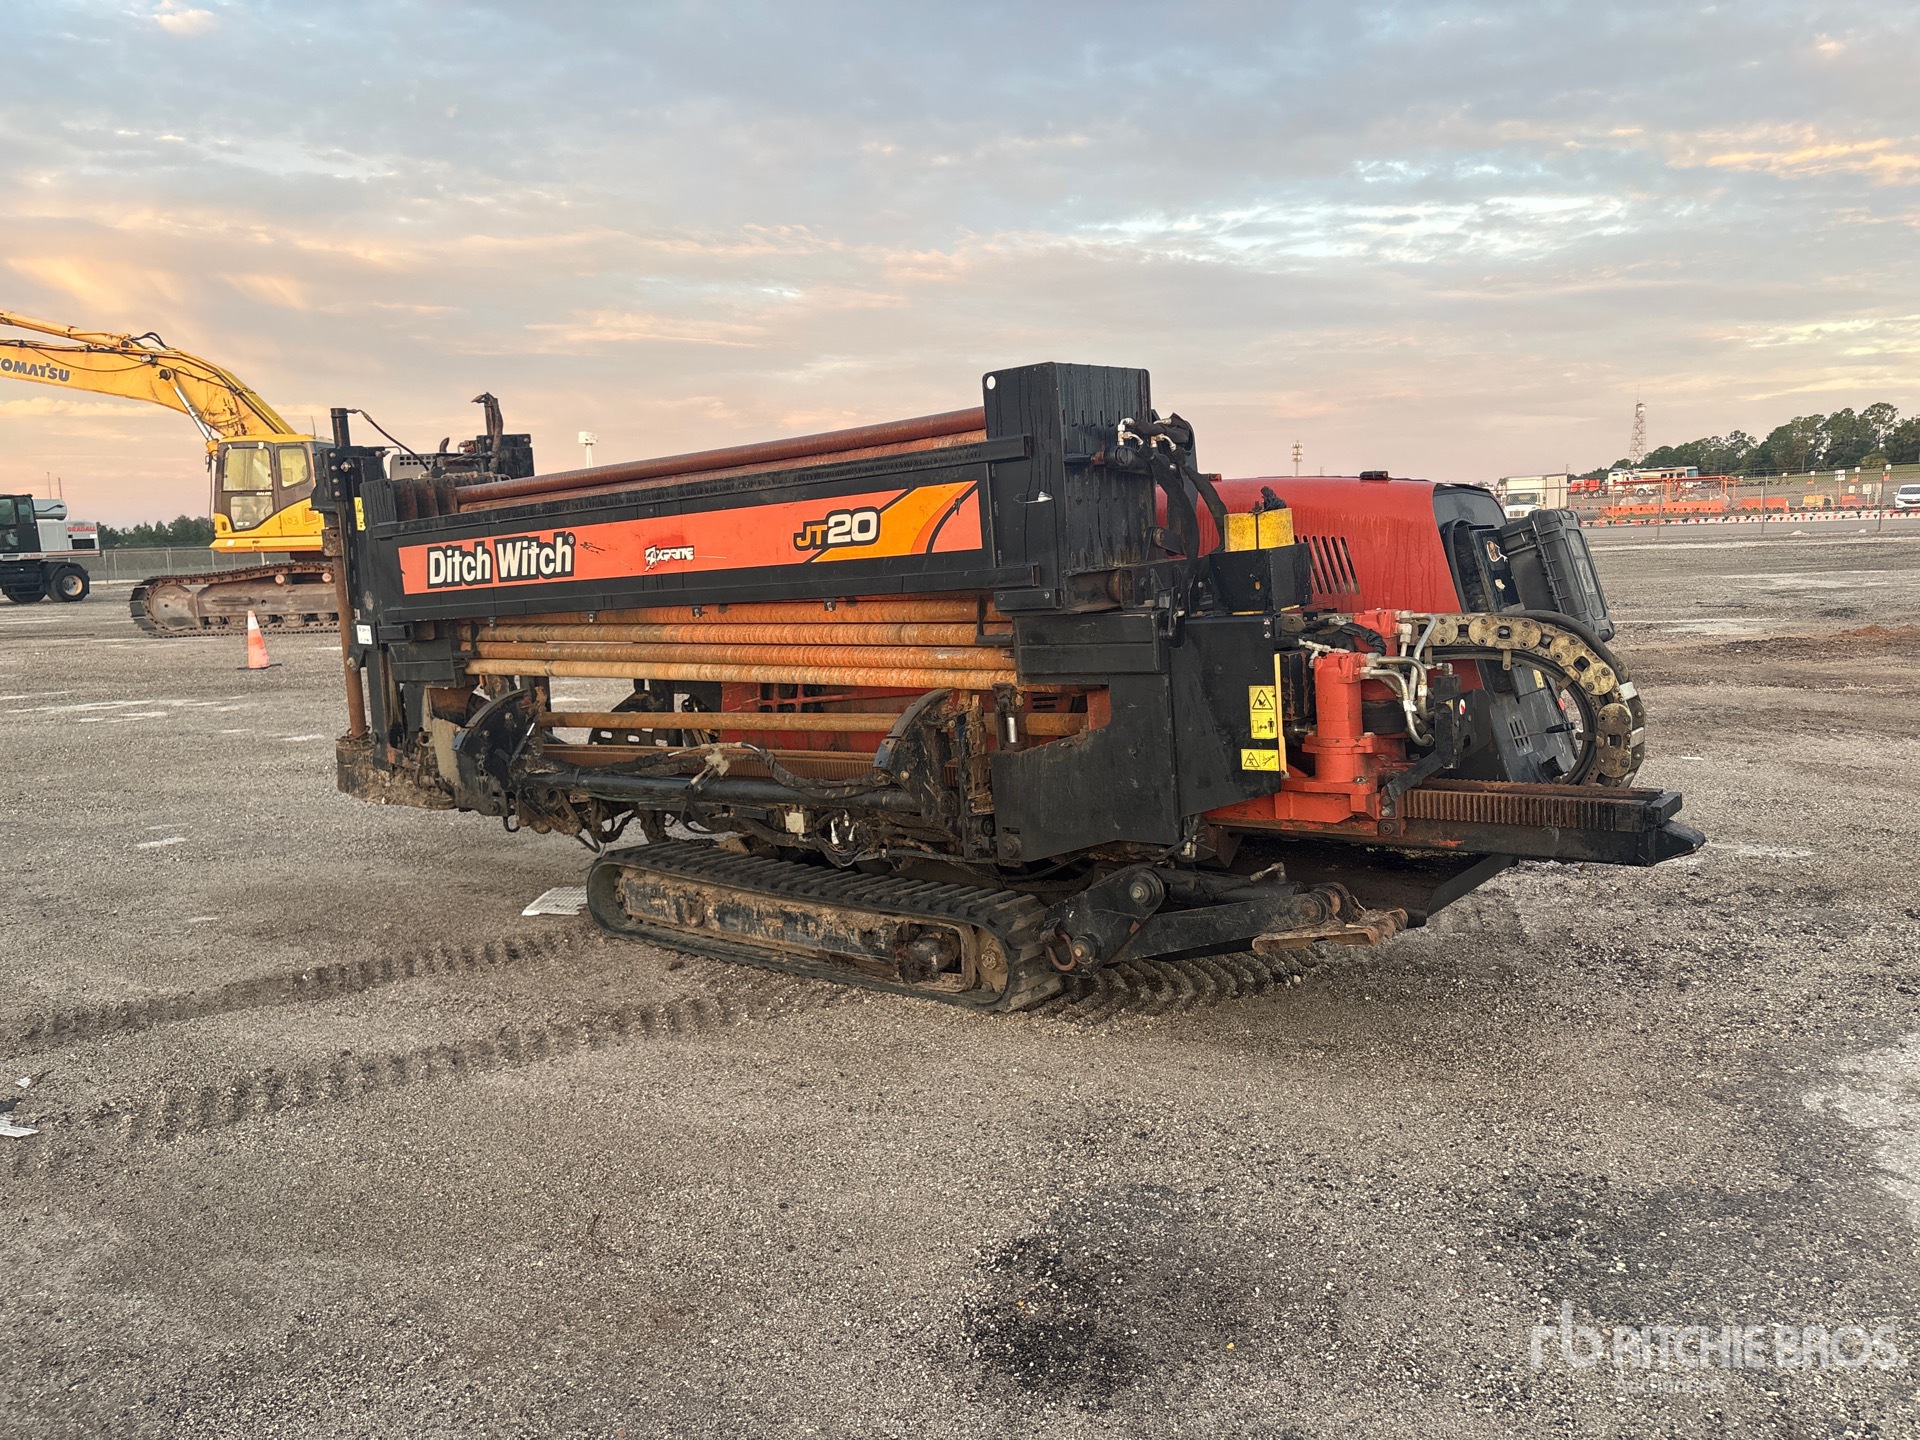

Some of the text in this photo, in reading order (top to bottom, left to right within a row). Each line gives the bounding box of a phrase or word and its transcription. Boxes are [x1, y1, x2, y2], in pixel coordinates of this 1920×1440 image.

[0, 358, 70, 382] OMATSU
[796, 511, 878, 547] JT20
[428, 536, 573, 585] Ditch Witch
